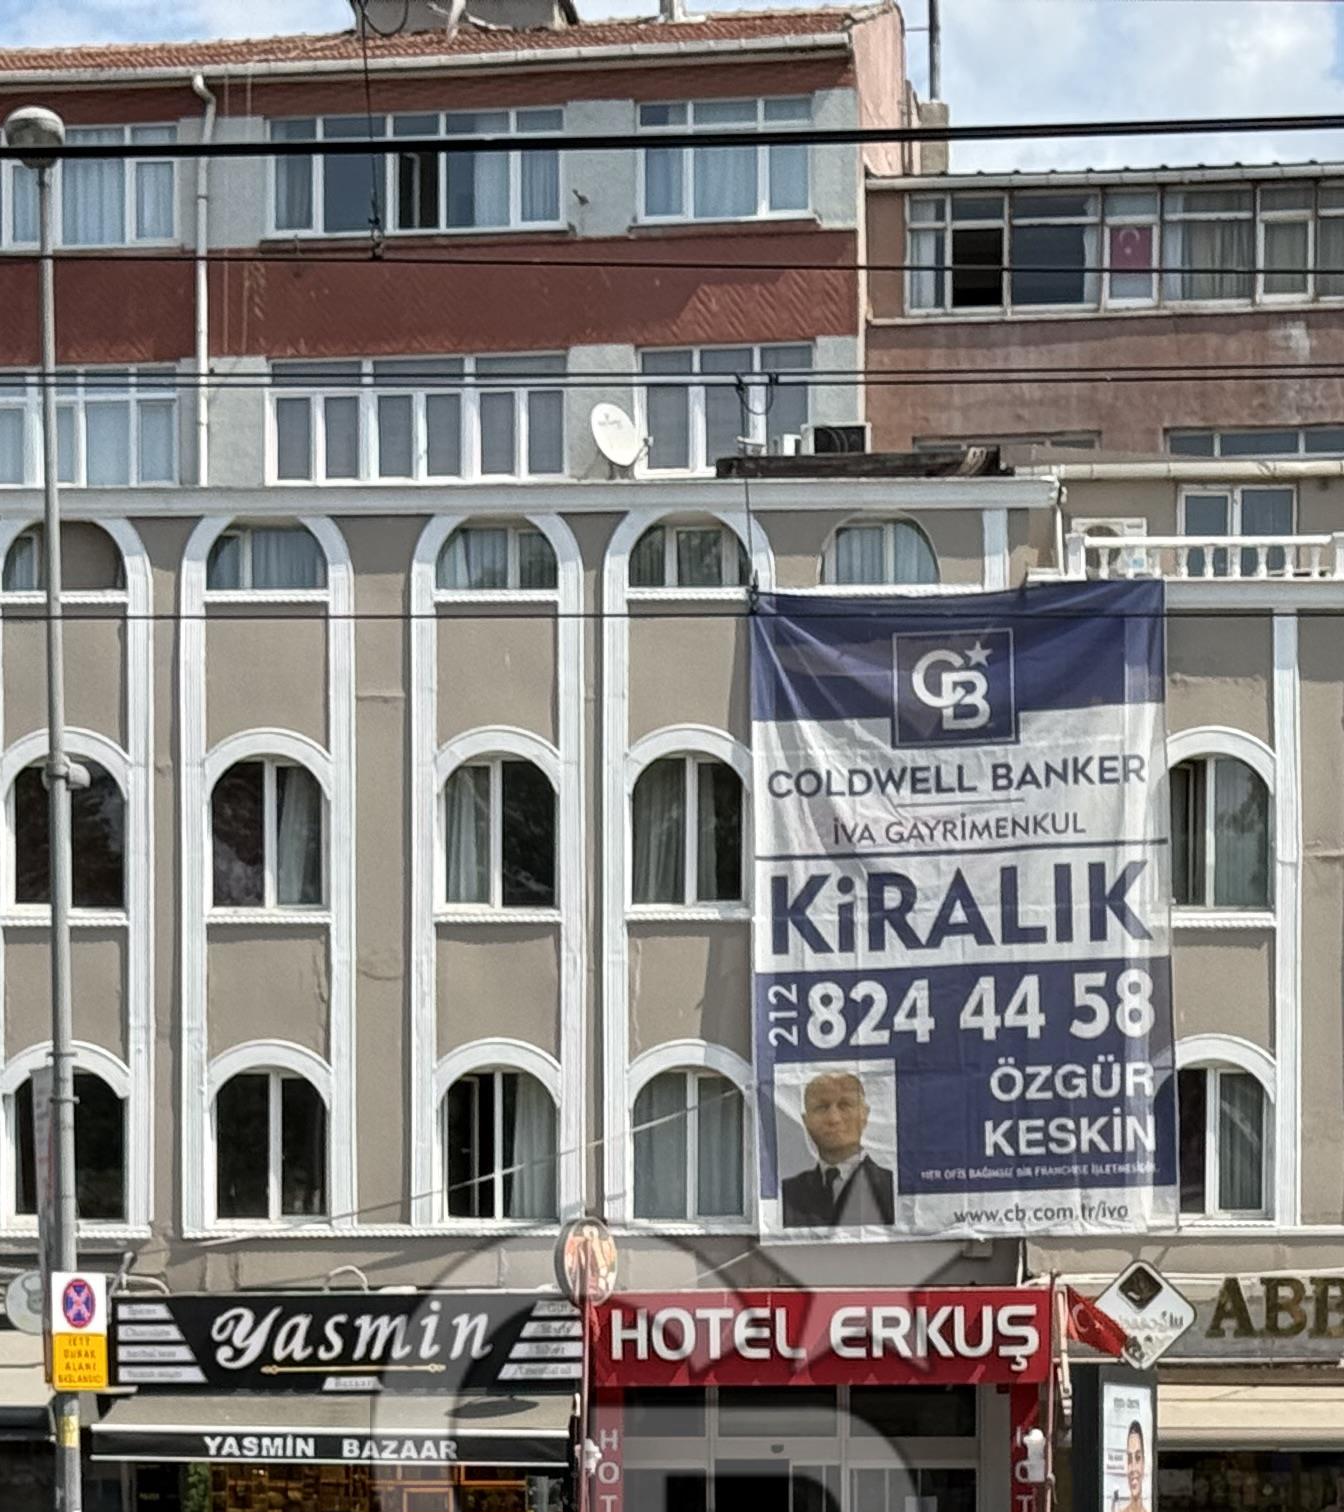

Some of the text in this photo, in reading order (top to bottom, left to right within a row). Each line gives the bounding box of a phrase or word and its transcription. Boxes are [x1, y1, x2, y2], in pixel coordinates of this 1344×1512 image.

[767, 754, 1146, 798] COLDWELL BANKER
[833, 812, 1086, 845] İVA GAYRİMENKUL
[767, 968, 1155, 1049] 212 824 44 58
[989, 1054, 1155, 1102] ÖZGÜR
[984, 1106, 1156, 1157] KESKİN
[211, 1300, 493, 1370] Yasmin
[610, 1303, 1041, 1372] HOTEL ERKUŞ
[204, 1434, 458, 1459] YASMİN BAZAAR
